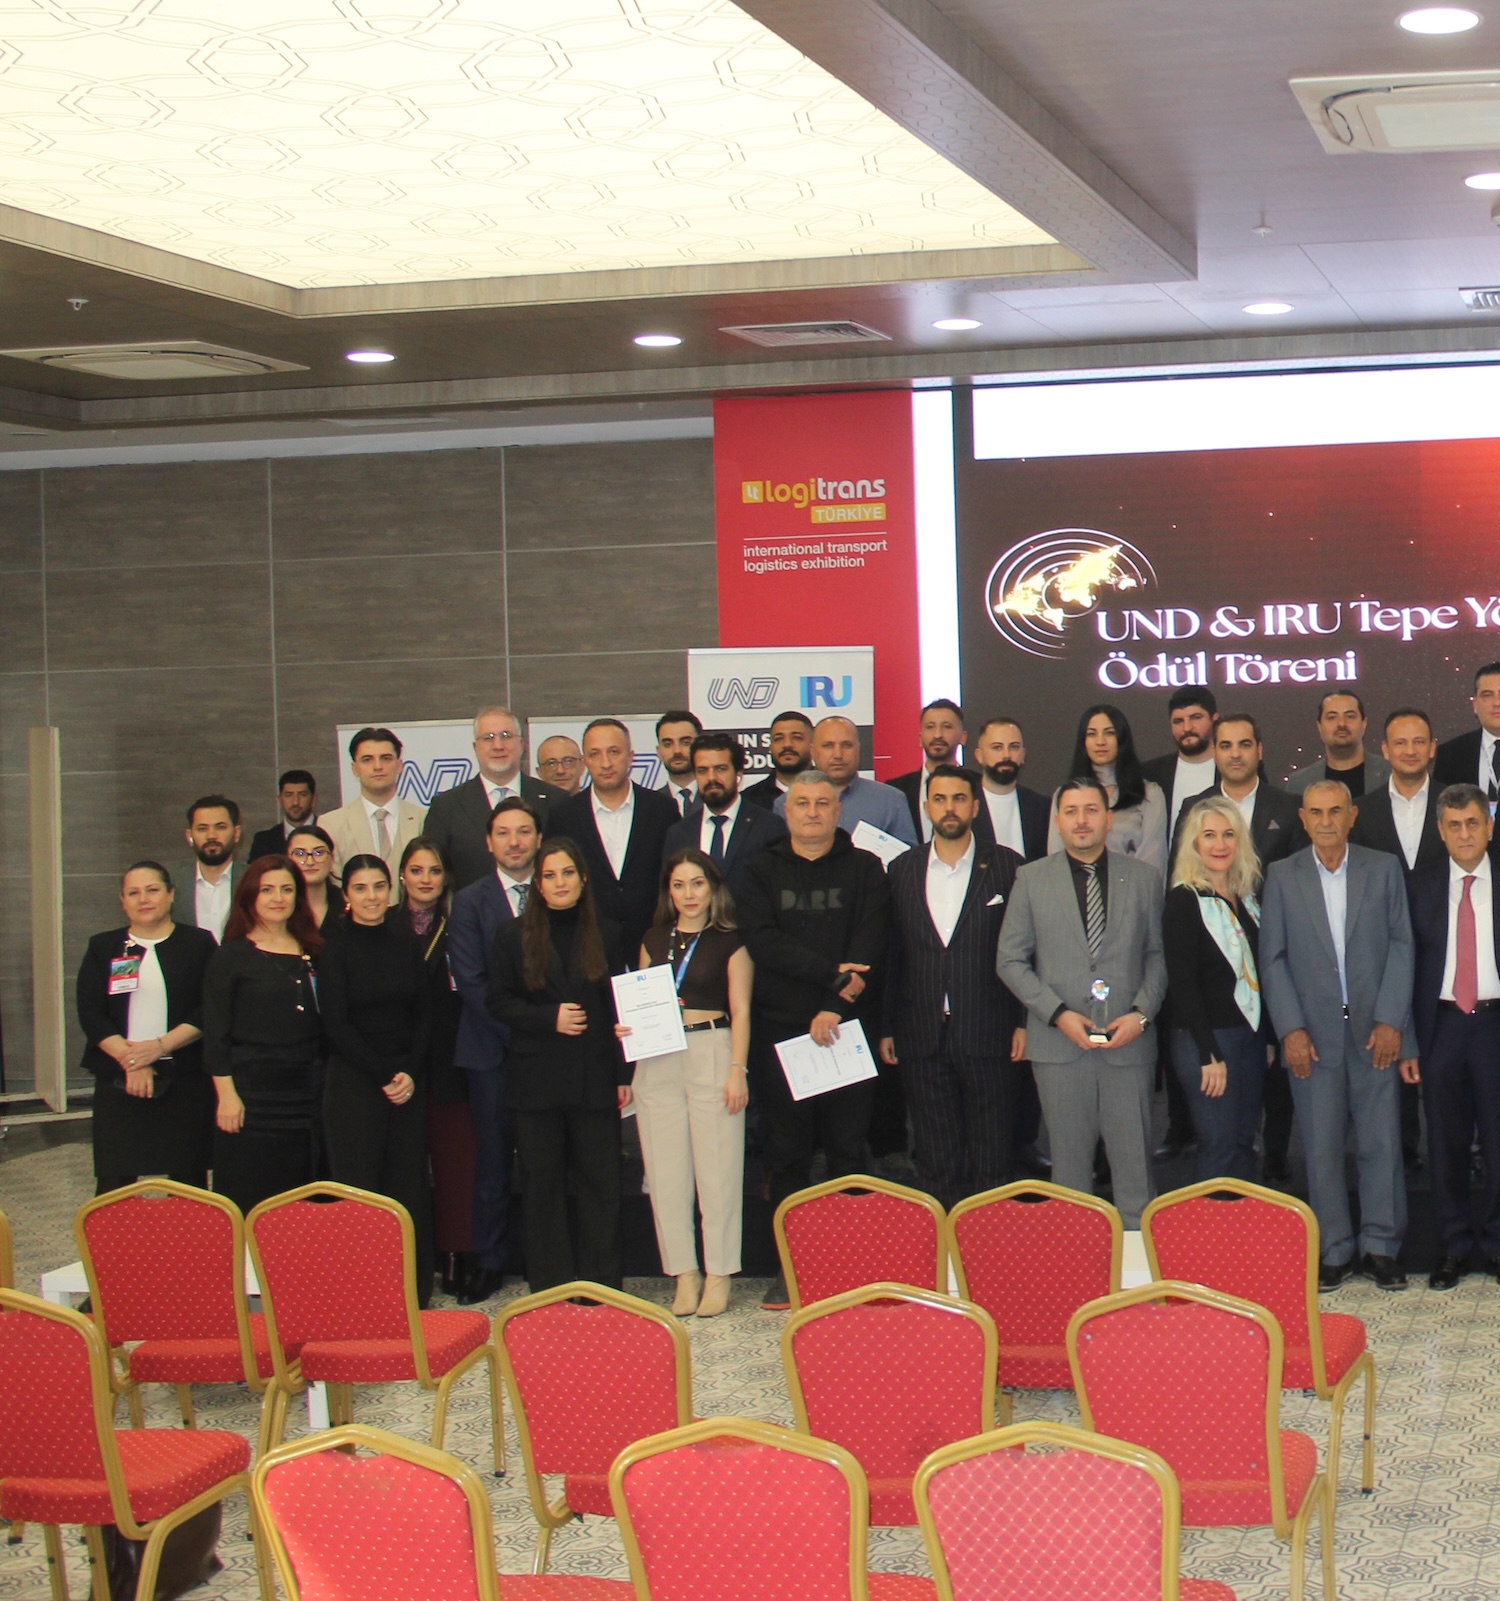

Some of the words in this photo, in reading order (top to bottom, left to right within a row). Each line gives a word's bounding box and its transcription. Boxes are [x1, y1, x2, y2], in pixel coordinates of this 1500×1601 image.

[765, 478, 886, 508] logitrans
[815, 505, 882, 521] TÜRKİYE
[743, 542, 823, 557] international
[827, 540, 887, 554] transport
[744, 558, 797, 574] logistics
[801, 556, 864, 569] exhibition
[1096, 608, 1200, 642] UND
[1209, 606, 1255, 637] &
[1263, 602, 1342, 636] IRU
[1350, 600, 1458, 641] Tepe
[1098, 651, 1208, 689] Ödül
[1215, 650, 1357, 685] Töreni
[707, 677, 779, 710] UND
[799, 675, 853, 708] IRU
[781, 888, 842, 910] DARK
